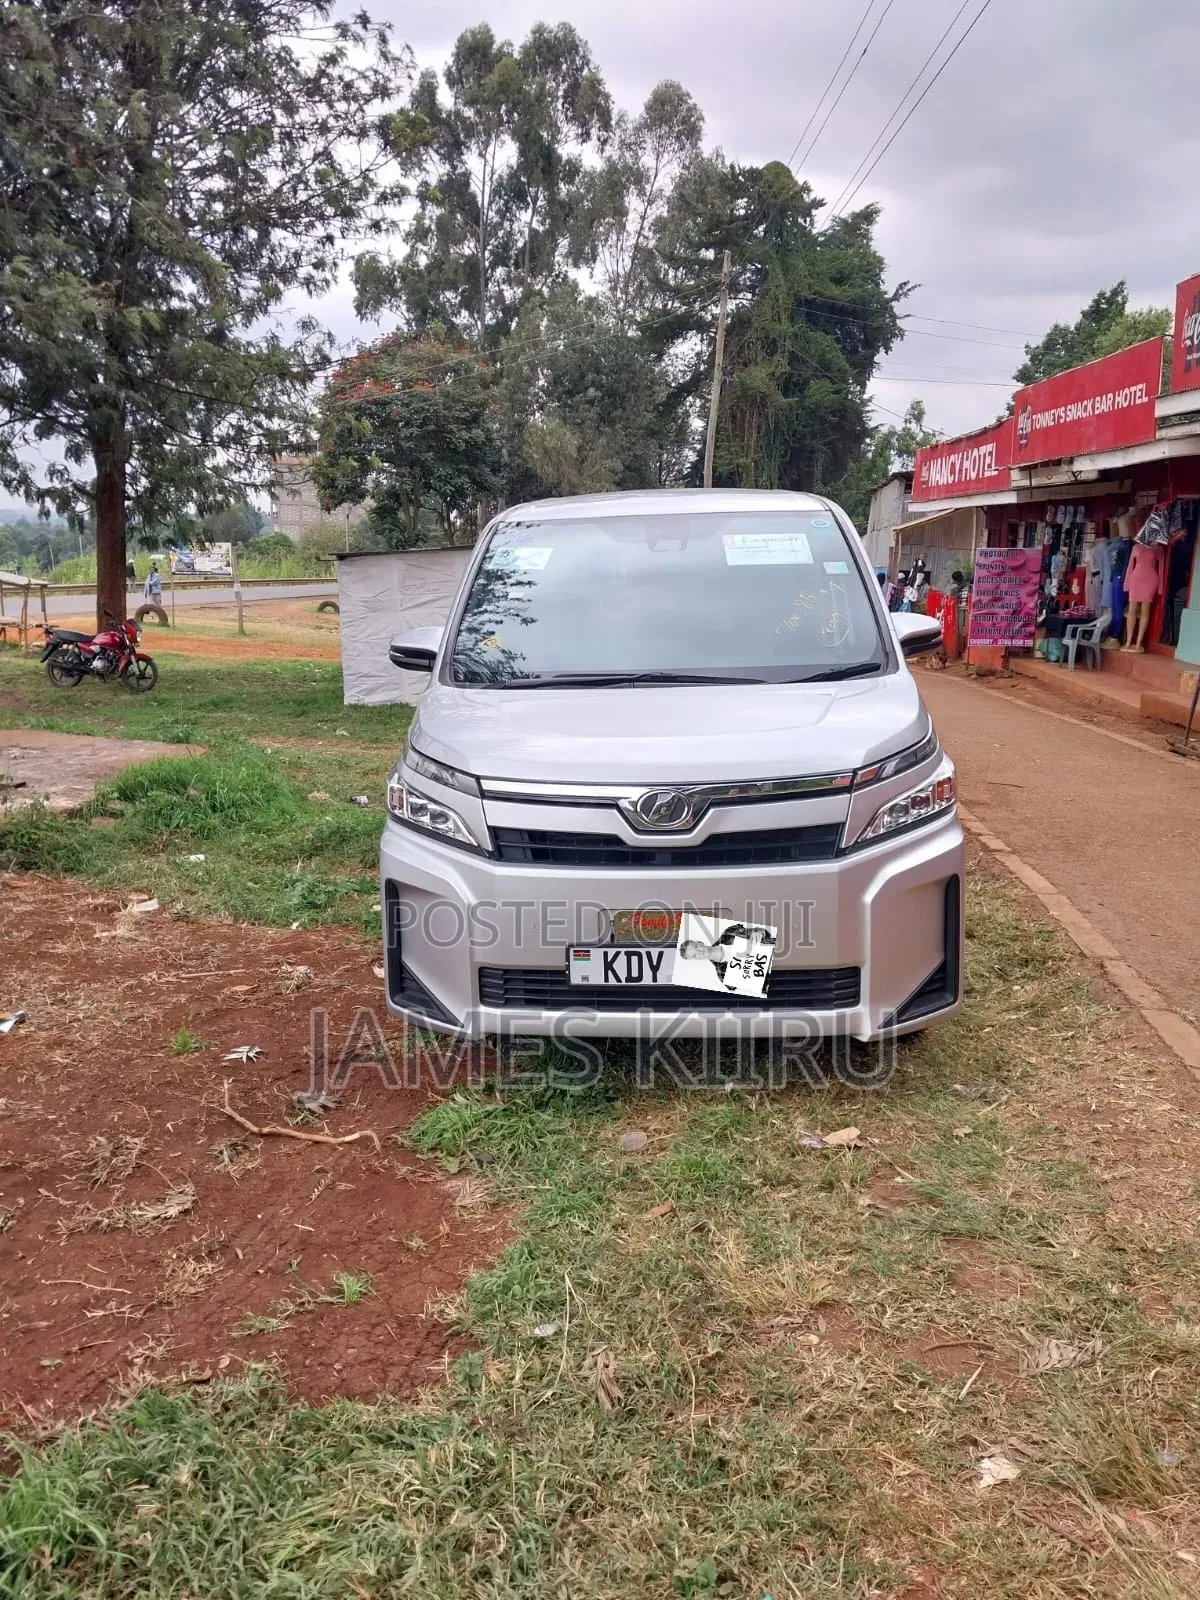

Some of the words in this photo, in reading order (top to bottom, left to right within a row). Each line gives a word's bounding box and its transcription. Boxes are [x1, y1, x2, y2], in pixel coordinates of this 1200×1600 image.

[1032, 406, 1065, 430] TONNEY'S
[1066, 398, 1094, 422] SNACK
[1094, 392, 1113, 415] BAR
[1114, 382, 1149, 410] HOTEL
[928, 452, 962, 487] NANCY
[961, 442, 998, 482] HOTEL
[603, 951, 664, 983] KDY
